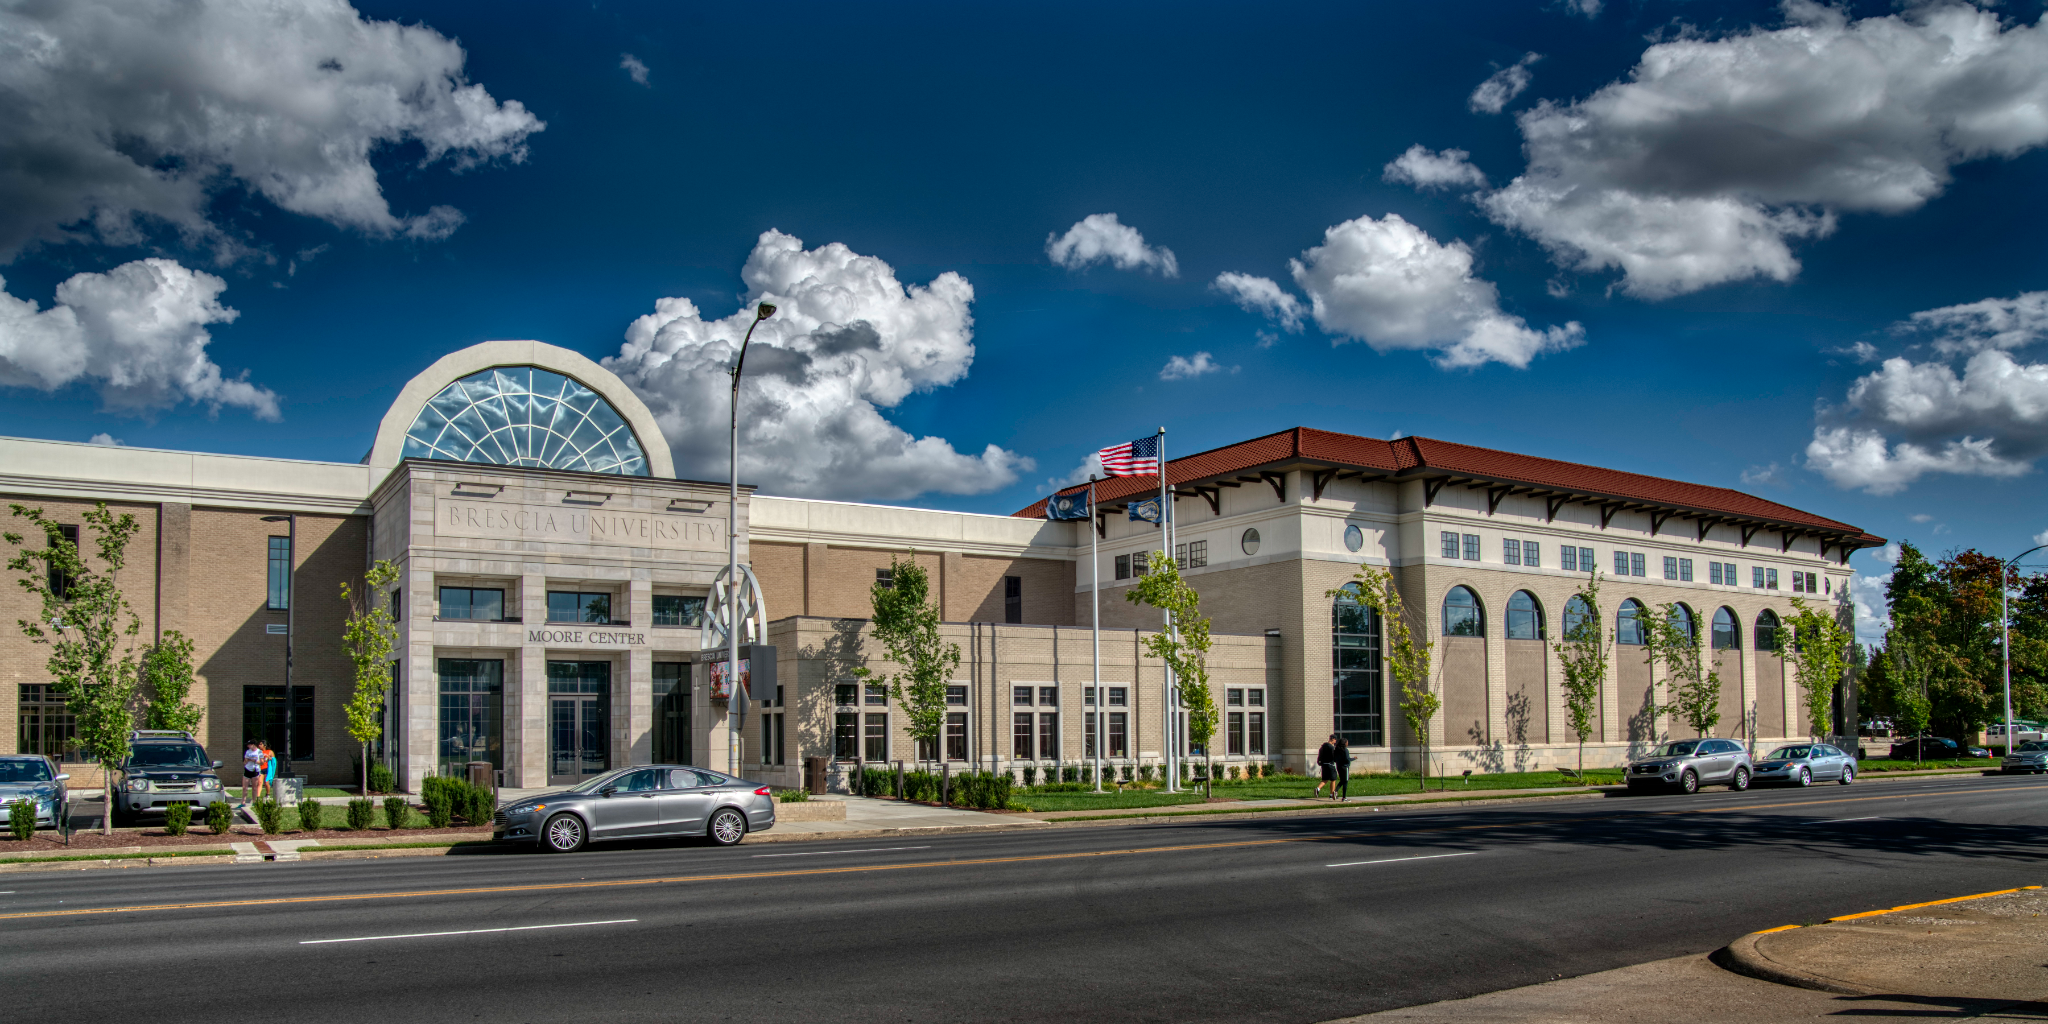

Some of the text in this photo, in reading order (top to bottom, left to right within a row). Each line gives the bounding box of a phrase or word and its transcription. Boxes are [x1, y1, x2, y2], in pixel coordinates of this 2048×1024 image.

[449, 506, 719, 542] BRESCIA UNIVERSITY
[528, 630, 646, 645] MOORE CENTER
